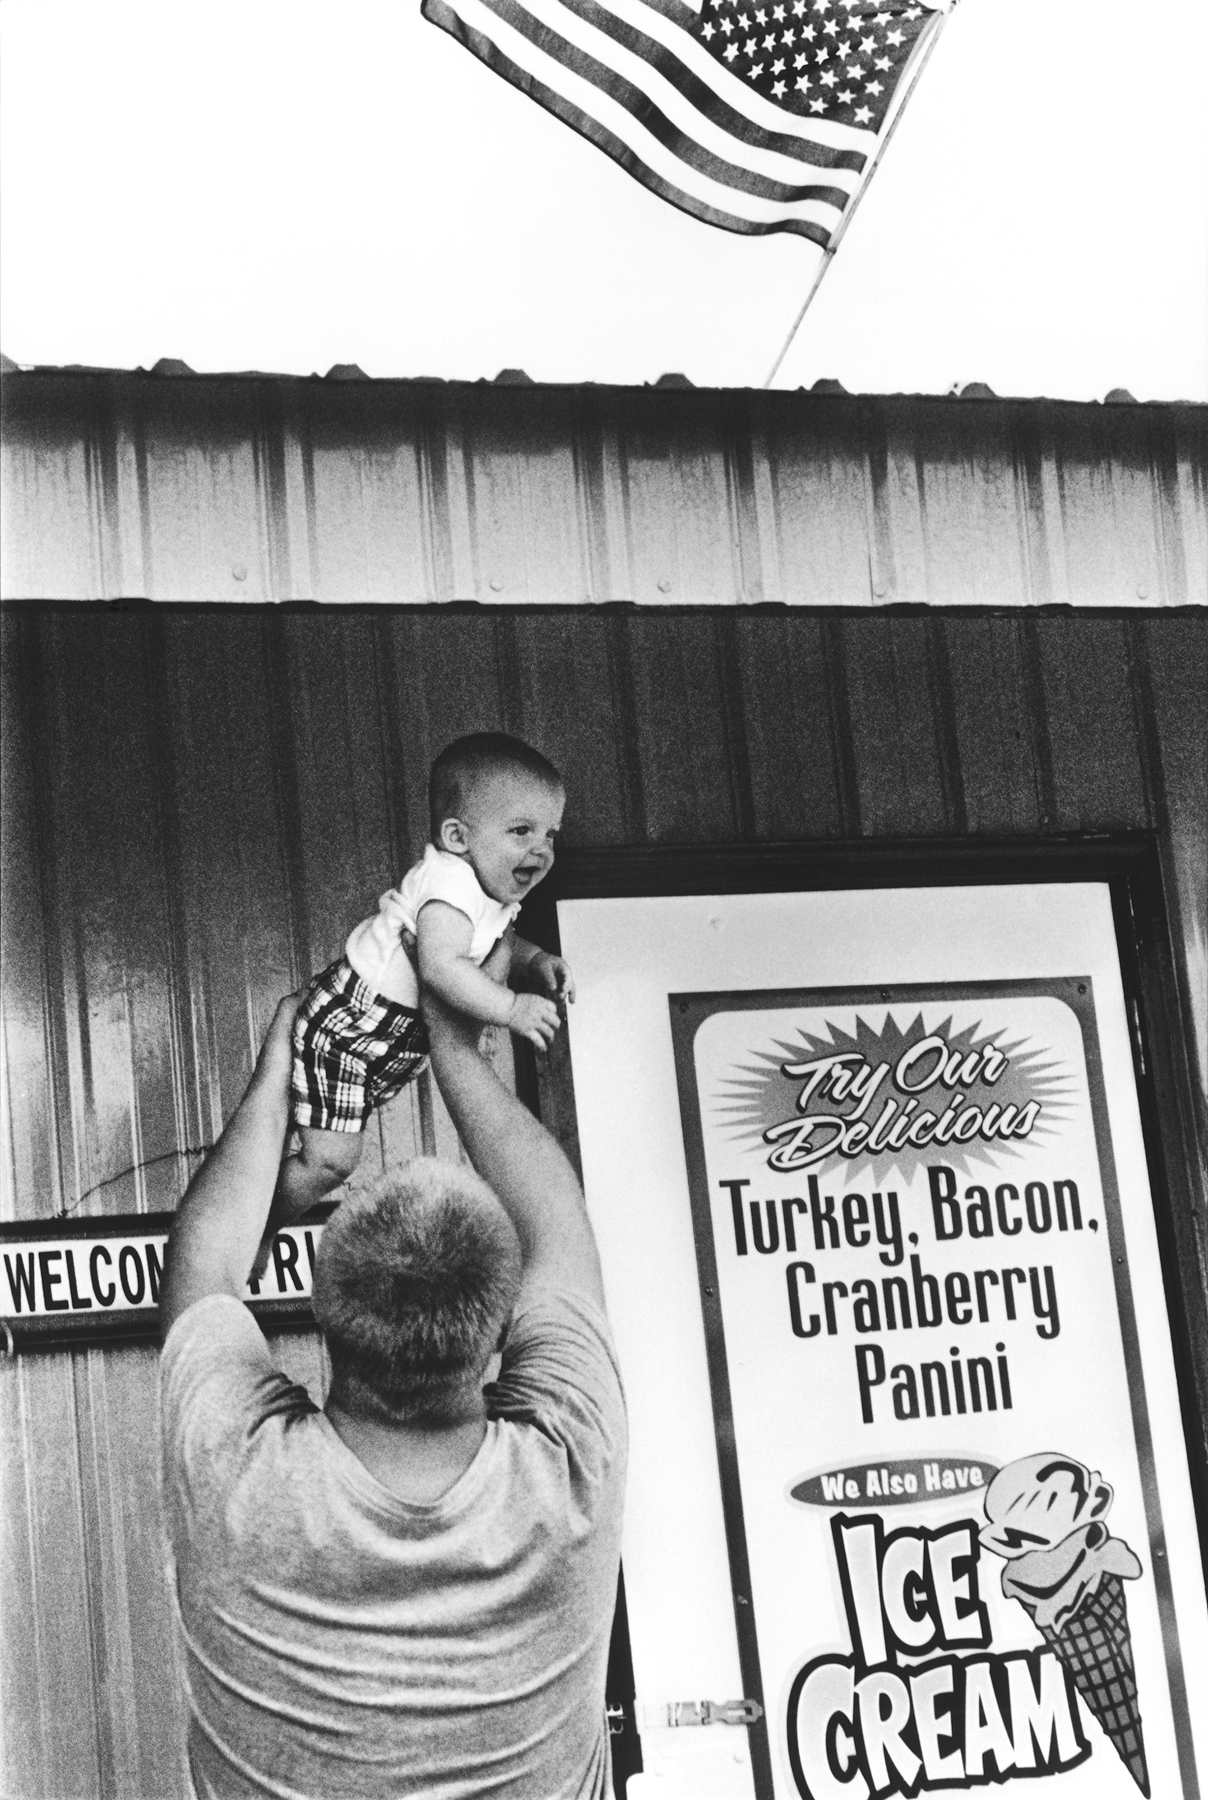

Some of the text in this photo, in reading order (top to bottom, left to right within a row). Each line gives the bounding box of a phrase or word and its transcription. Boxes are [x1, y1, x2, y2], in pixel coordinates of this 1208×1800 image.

[780, 1035, 1009, 1121] Try Our
[763, 1093, 1042, 1173] Delicious
[719, 1165, 1099, 1267] Turkey, Bacon,
[3, 1242, 168, 1313] WELCOM
[785, 1254, 1061, 1340] Cranberry
[855, 1341, 1013, 1424] Panini
[820, 1462, 985, 1501] We Also Have
[830, 1512, 993, 1667] ICE
[787, 1647, 1093, 1800] CREAM
